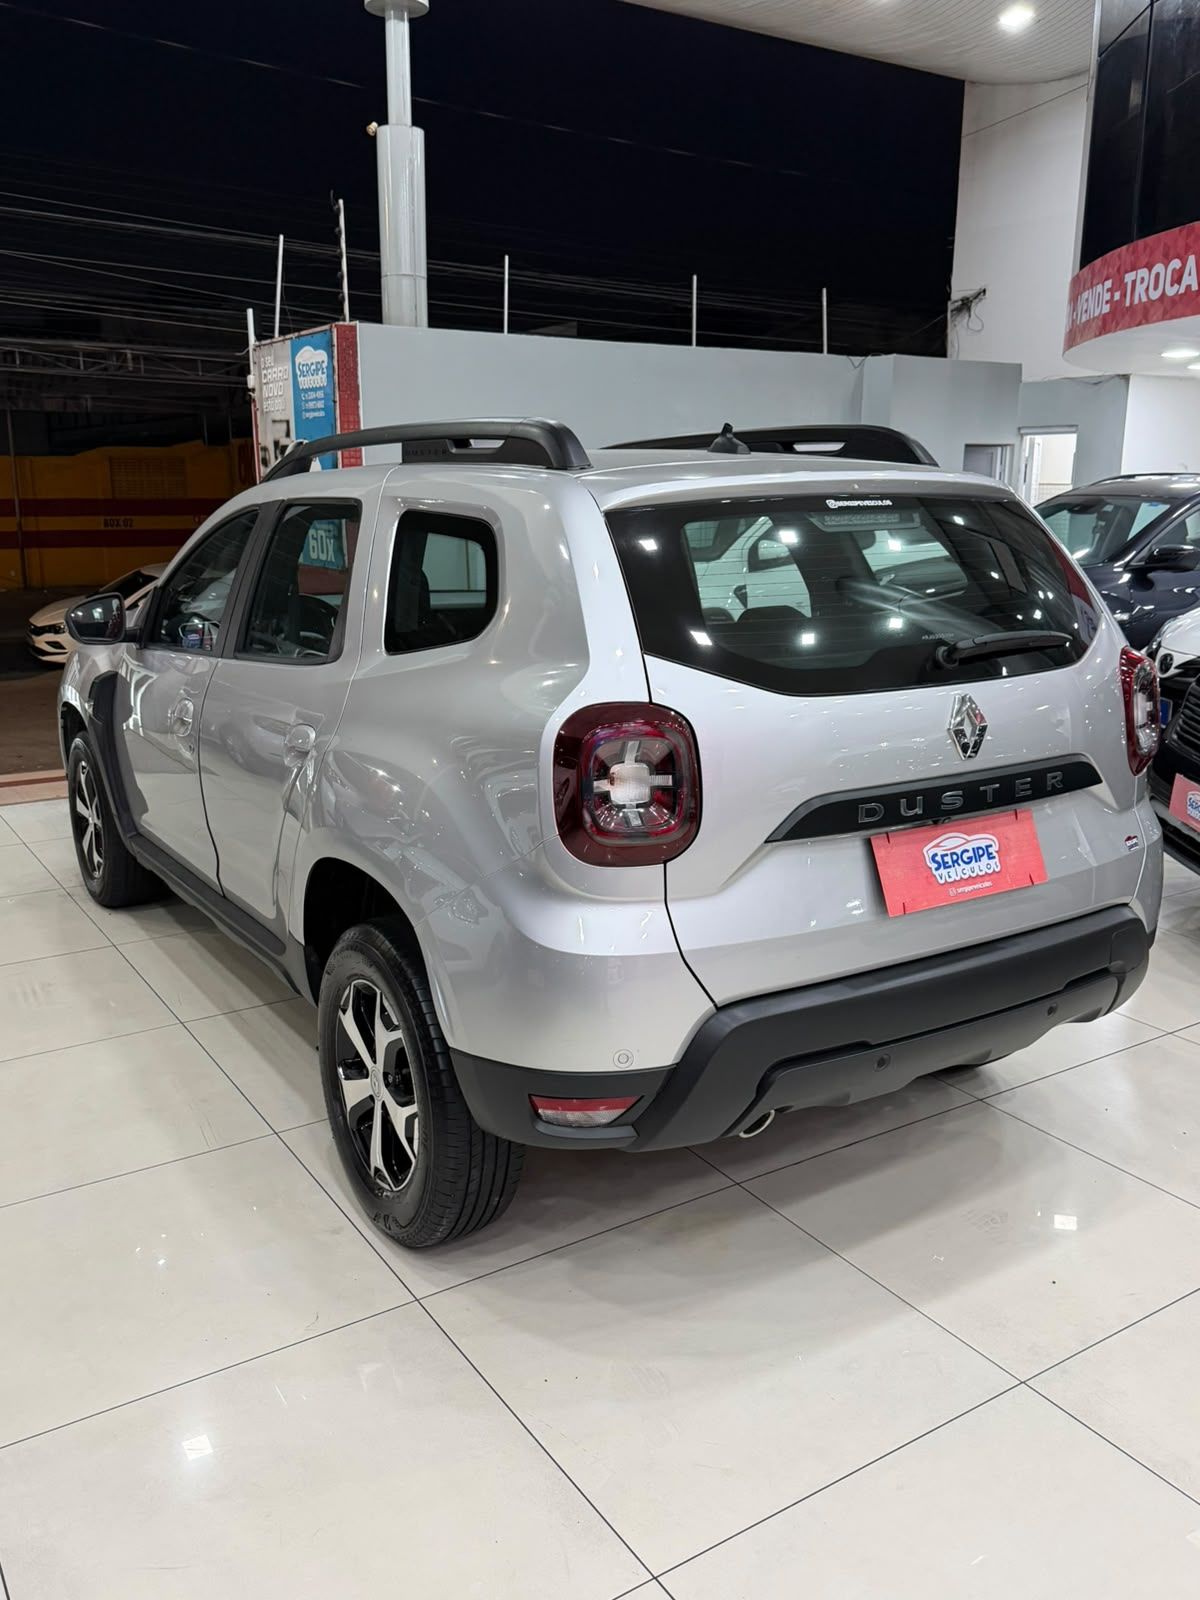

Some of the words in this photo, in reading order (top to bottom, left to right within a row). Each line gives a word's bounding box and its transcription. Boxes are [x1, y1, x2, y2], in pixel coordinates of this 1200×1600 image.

[1077, 279, 1112, 325] VENDE
[1124, 254, 1199, 308] TROCA
[261, 366, 289, 384] CARRO
[298, 360, 326, 378] SERGIPE
[262, 382, 284, 398] NOVO
[103, 518, 120, 529] BOX
[858, 771, 1064, 823] DUSTER
[931, 844, 996, 872] SERGIPE
[938, 861, 999, 881] VEÍCULOS
